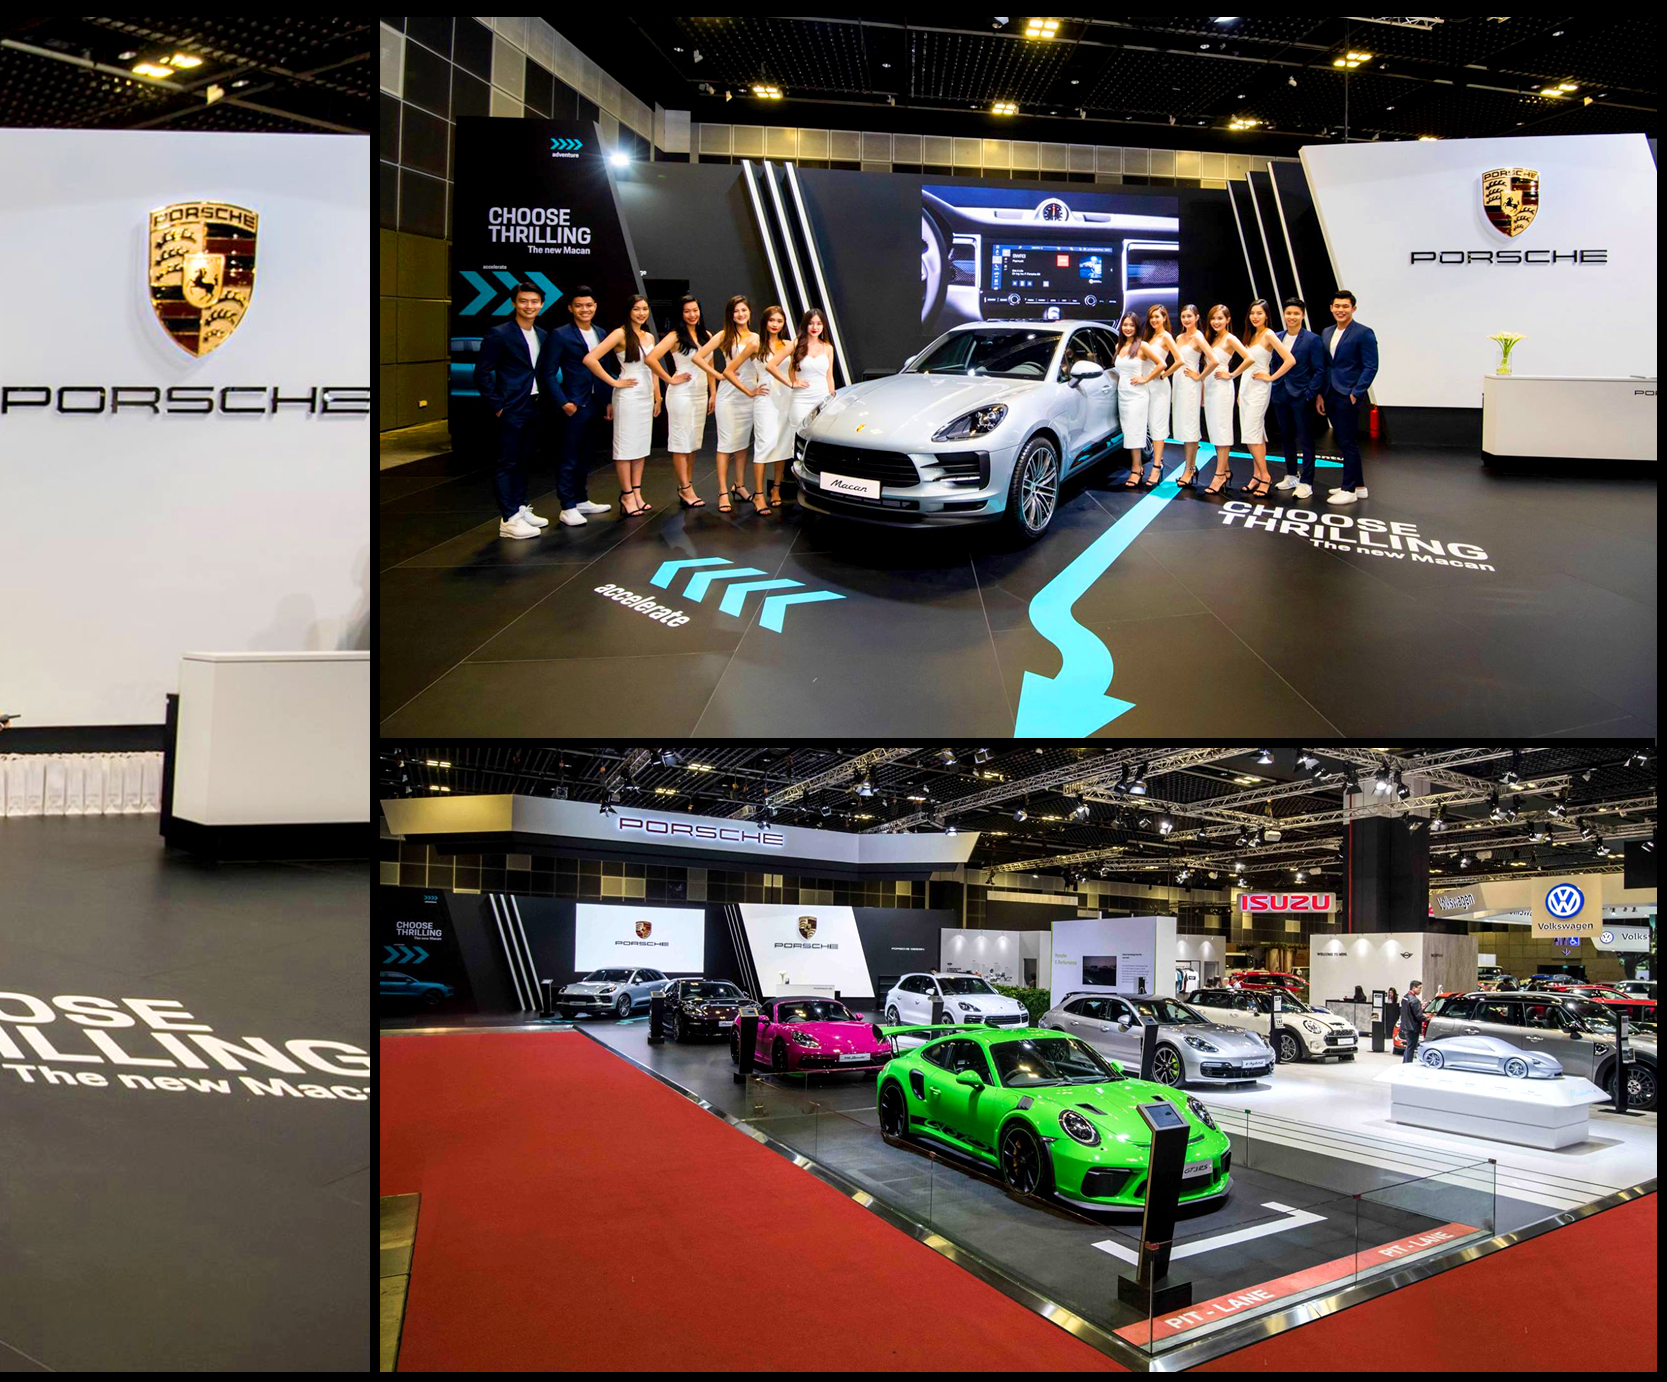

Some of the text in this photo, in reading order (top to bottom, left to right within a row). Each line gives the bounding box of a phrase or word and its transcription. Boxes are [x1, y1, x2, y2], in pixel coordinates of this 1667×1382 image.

[154, 206, 255, 230] PORSCHE
[489, 207, 571, 226] CHOOSE
[488, 225, 591, 245] THRILLING
[528, 245, 543, 254] The
[563, 246, 591, 255] Macan
[1410, 249, 1608, 264] PORSCHE
[0, 386, 370, 415] PORSCHE
[830, 479, 868, 493] Macan
[1222, 500, 1420, 537] CHOOSE
[1217, 511, 1489, 560] THRILLING
[1309, 538, 1496, 572] The new Macan
[594, 583, 691, 627] accelerate
[619, 817, 784, 846] PORSCHE
[1242, 895, 1330, 911] ISUZU
[1436, 892, 1476, 911] Volkswagen
[396, 921, 433, 929] CHOOSE
[396, 928, 442, 937] THRILLING
[1537, 921, 1594, 931] Volkswagen
[774, 942, 839, 950] PORSCHE
[1, 1063, 109, 1087] The
[117, 1074, 232, 1094] new
[1378, 1243, 1407, 1258] PIT
[1415, 1230, 1455, 1248] LANE
[1162, 1308, 1204, 1330] PIT
[1219, 1288, 1275, 1314] LANE
